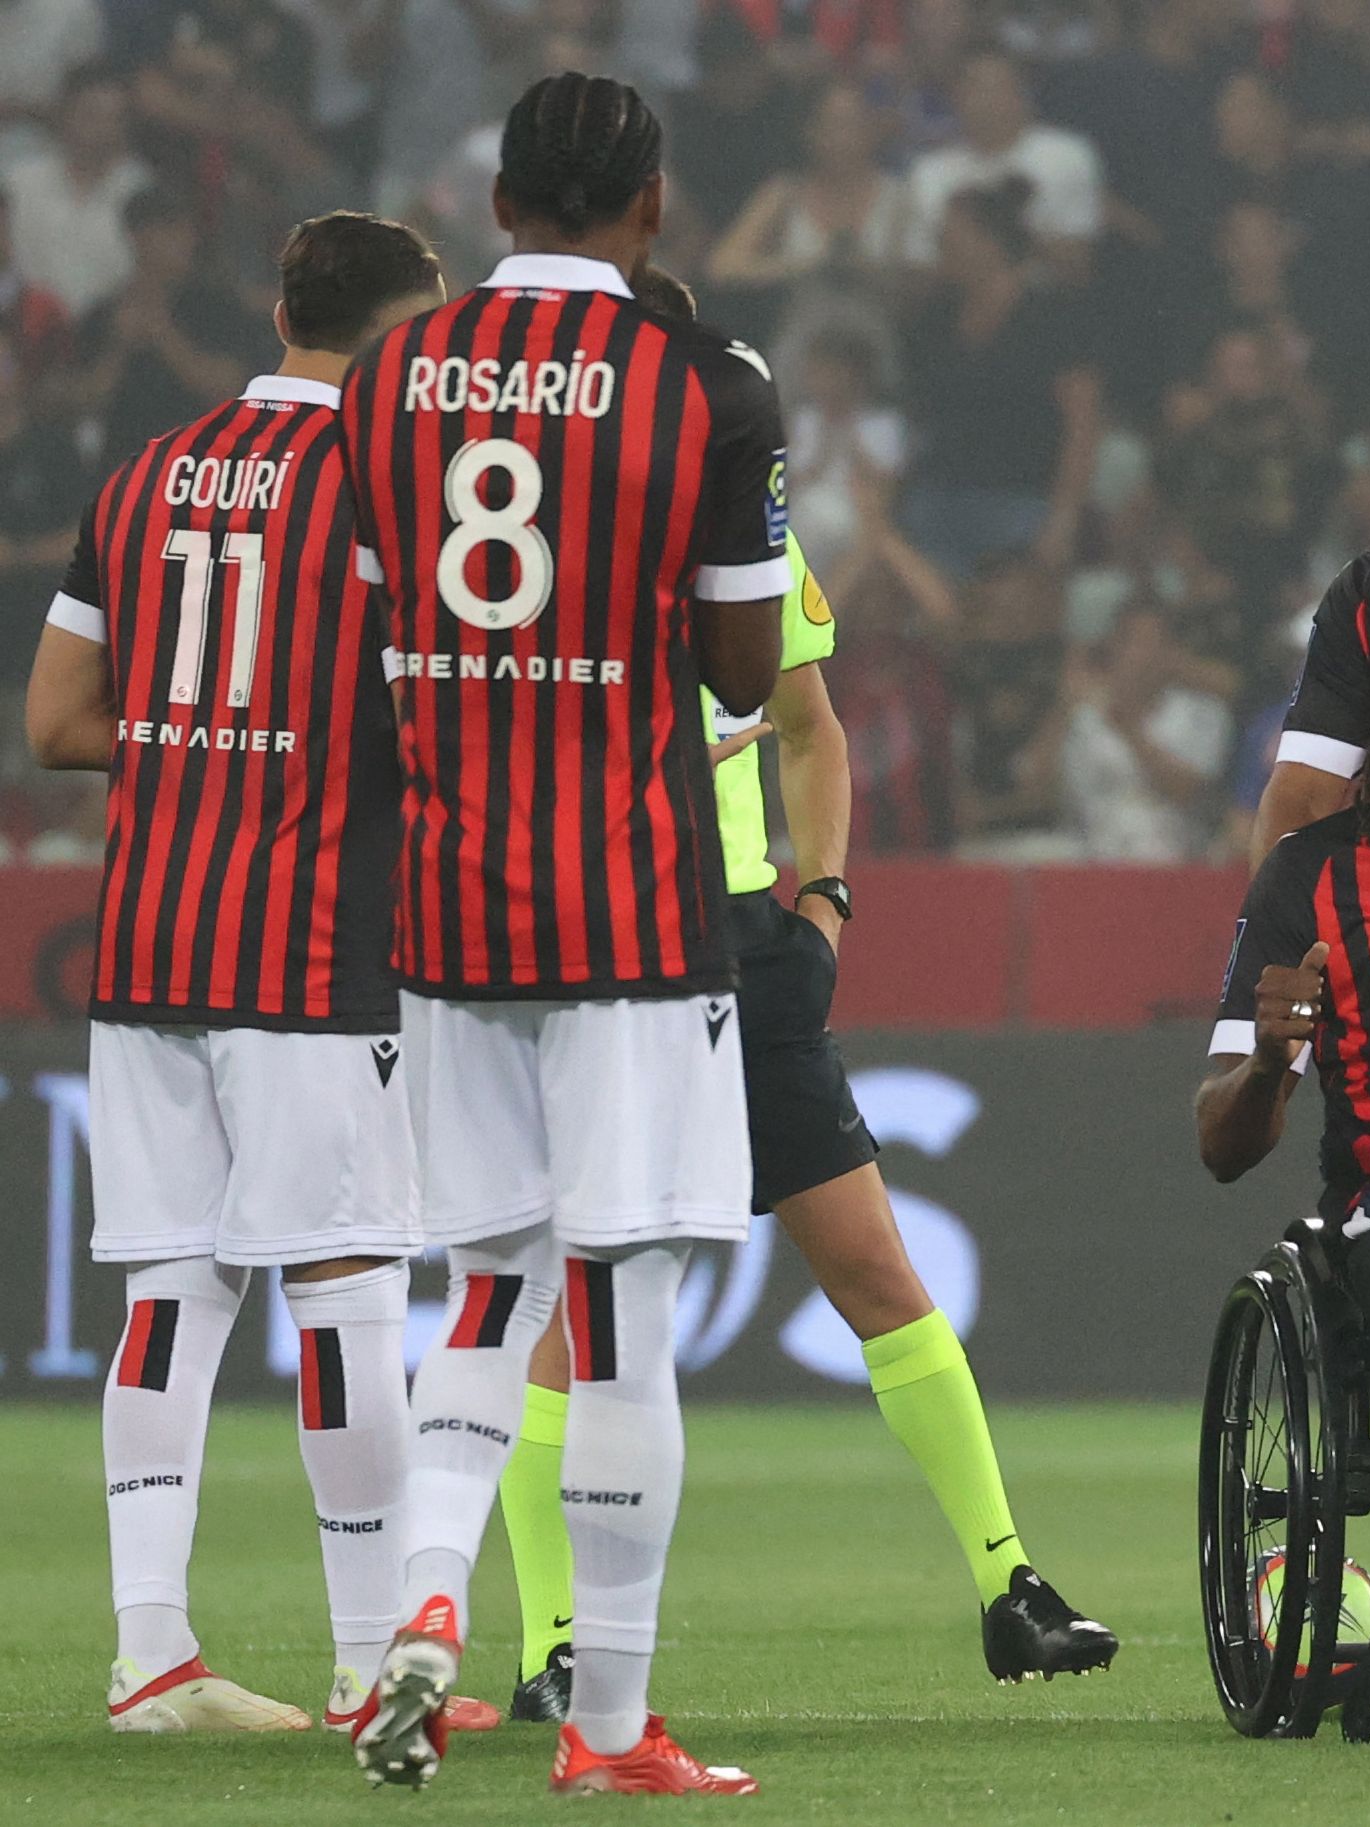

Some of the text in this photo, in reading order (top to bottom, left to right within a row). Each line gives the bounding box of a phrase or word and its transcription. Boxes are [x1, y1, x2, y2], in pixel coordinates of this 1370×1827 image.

[436, 437, 554, 629] 8
[160, 529, 266, 708] 11
[117, 719, 297, 754] RENADIER
[109, 1474, 184, 1496] OGC NICE
[342, 1518, 384, 1534] NICE
